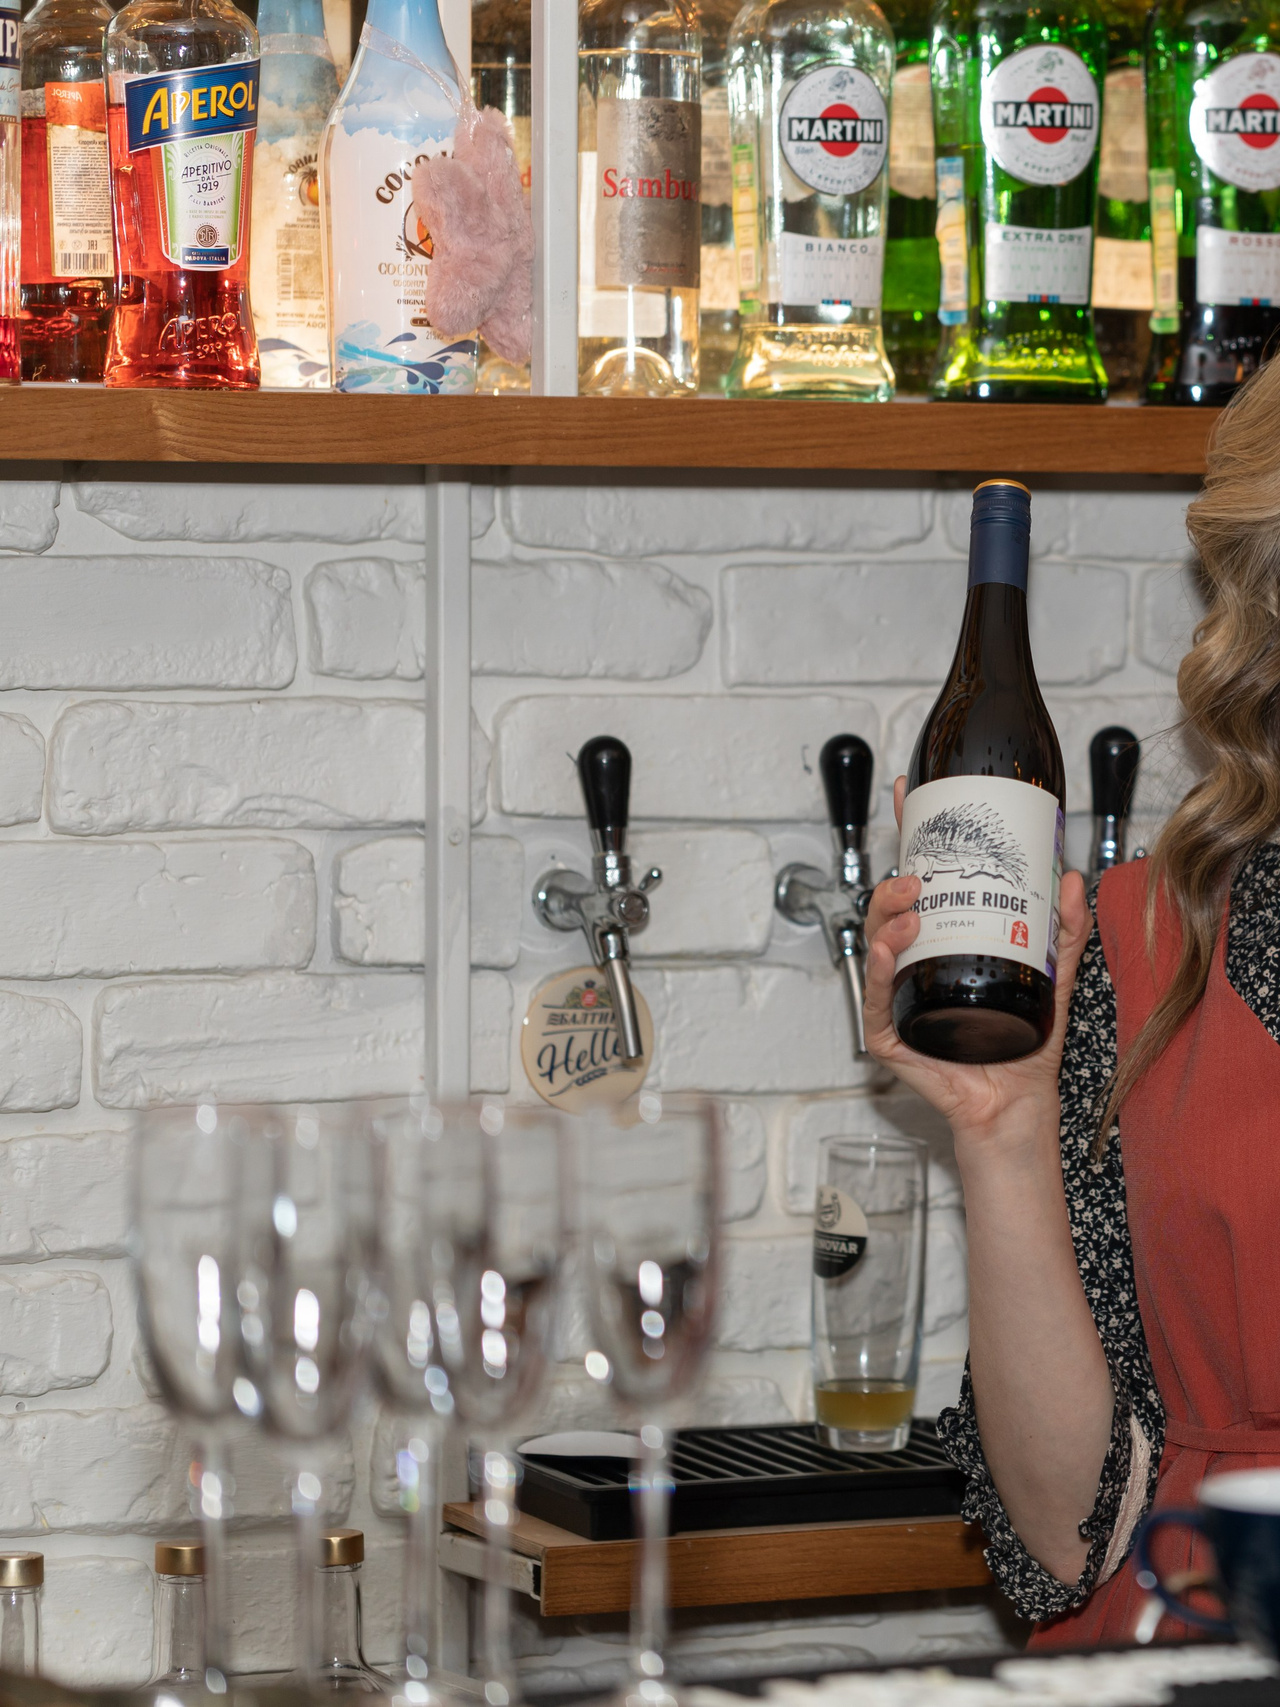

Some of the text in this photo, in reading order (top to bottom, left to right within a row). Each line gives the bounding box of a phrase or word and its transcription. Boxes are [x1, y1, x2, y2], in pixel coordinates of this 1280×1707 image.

[142, 80, 256, 135] APEROL
[996, 103, 1091, 127] MARTINI
[791, 119, 882, 142] MARTINI
[184, 143, 228, 158] RICETTA ORIGINALE
[181, 160, 231, 179] APERITIVO
[197, 180, 219, 193] 1919
[1002, 231, 1084, 244] EXTRA DRY
[805, 242, 868, 254] BIANCO
[907, 891, 976, 914] RCUPINE
[982, 891, 1028, 915] RIDGE
[936, 921, 974, 930] SYRAH
